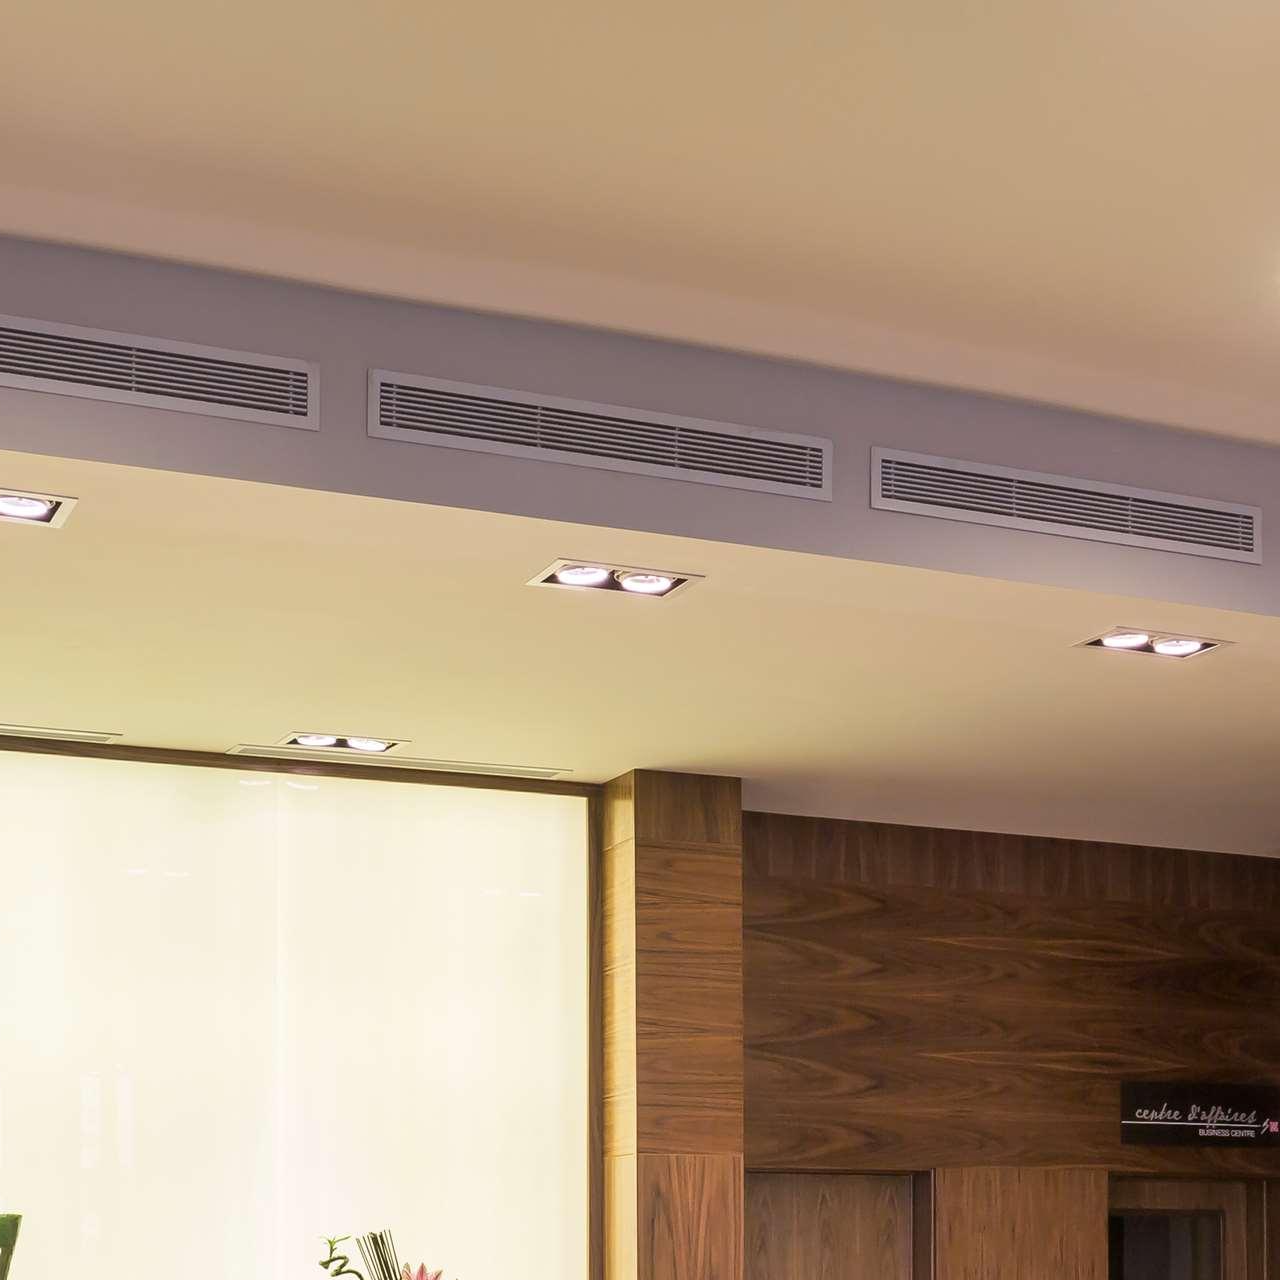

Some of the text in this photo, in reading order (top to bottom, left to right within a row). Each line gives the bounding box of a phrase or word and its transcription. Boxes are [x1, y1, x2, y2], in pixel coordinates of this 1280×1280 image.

[1135, 1102, 1257, 1128] centre d'affaires
[1198, 1128, 1256, 1138] BUSINESS CENTRE
